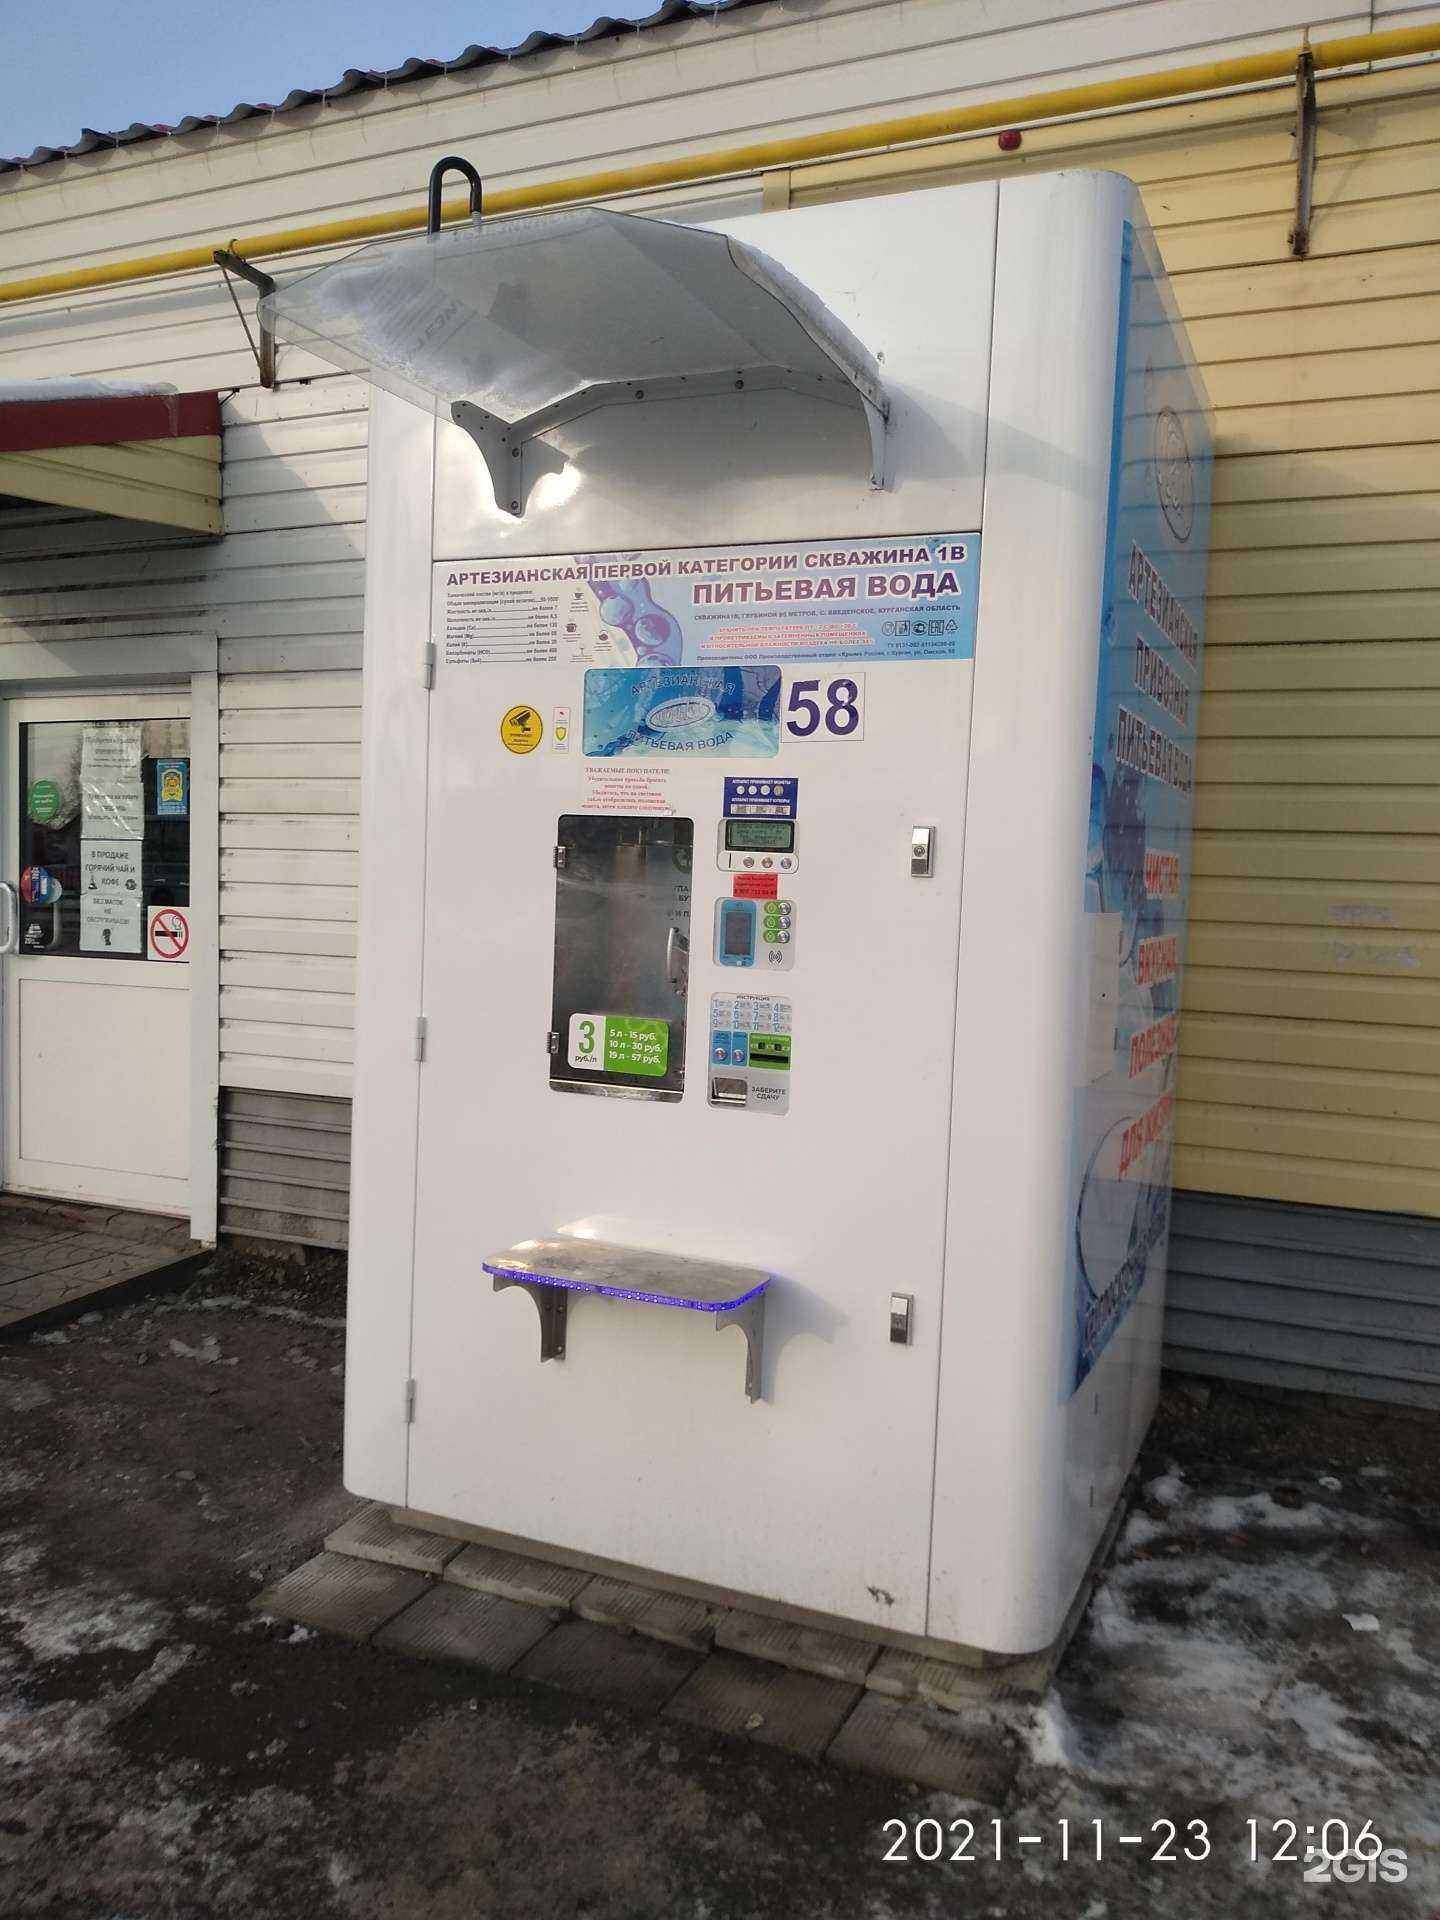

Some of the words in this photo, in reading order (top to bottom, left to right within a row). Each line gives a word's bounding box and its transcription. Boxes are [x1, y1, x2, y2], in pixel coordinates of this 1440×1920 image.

[447, 566, 587, 586] АРТЕЗИАНСКАЯ
[594, 559, 671, 579] ПЕРВОЙ
[678, 555, 797, 575] КАТЕГОРИИ
[805, 548, 929, 568] СКВАЖИНА
[938, 546, 965, 561] 1В
[693, 578, 856, 604] ПИТЬЕВАЯ
[867, 572, 959, 598] ВОДА
[878, 606, 924, 614] КУРГАНСКАЯ
[926, 604, 961, 612] ОБЛАСТЬ
[787, 679, 859, 736] 58
[698, 732, 734, 749] ВОДА
[97, 850, 129, 859] ПРОДАЖЕ
[85, 864, 115, 872] ГОРЯЧИЙ
[116, 864, 129, 873] ЧАЙ
[101, 878, 120, 886] КОФЕ
[734, 1000, 740, 1009] 2
[753, 1001, 759, 1011] 3
[578, 1020, 595, 1054] 3
[609, 1029, 616, 1037] 5
[629, 1031, 638, 1039] 15
[638, 1032, 657, 1042] руб.
[609, 1040, 618, 1048] 10
[631, 1042, 643, 1050] 30
[644, 1044, 662, 1053] руб.
[574, 1054, 598, 1063] руб./л
[608, 1051, 618, 1059] 19
[631, 1053, 642, 1061] 57
[642, 1055, 661, 1064] руб.
[751, 1086, 787, 1095] ЗАБЕРИТЕ
[756, 1093, 780, 1101] СДАЧУ
